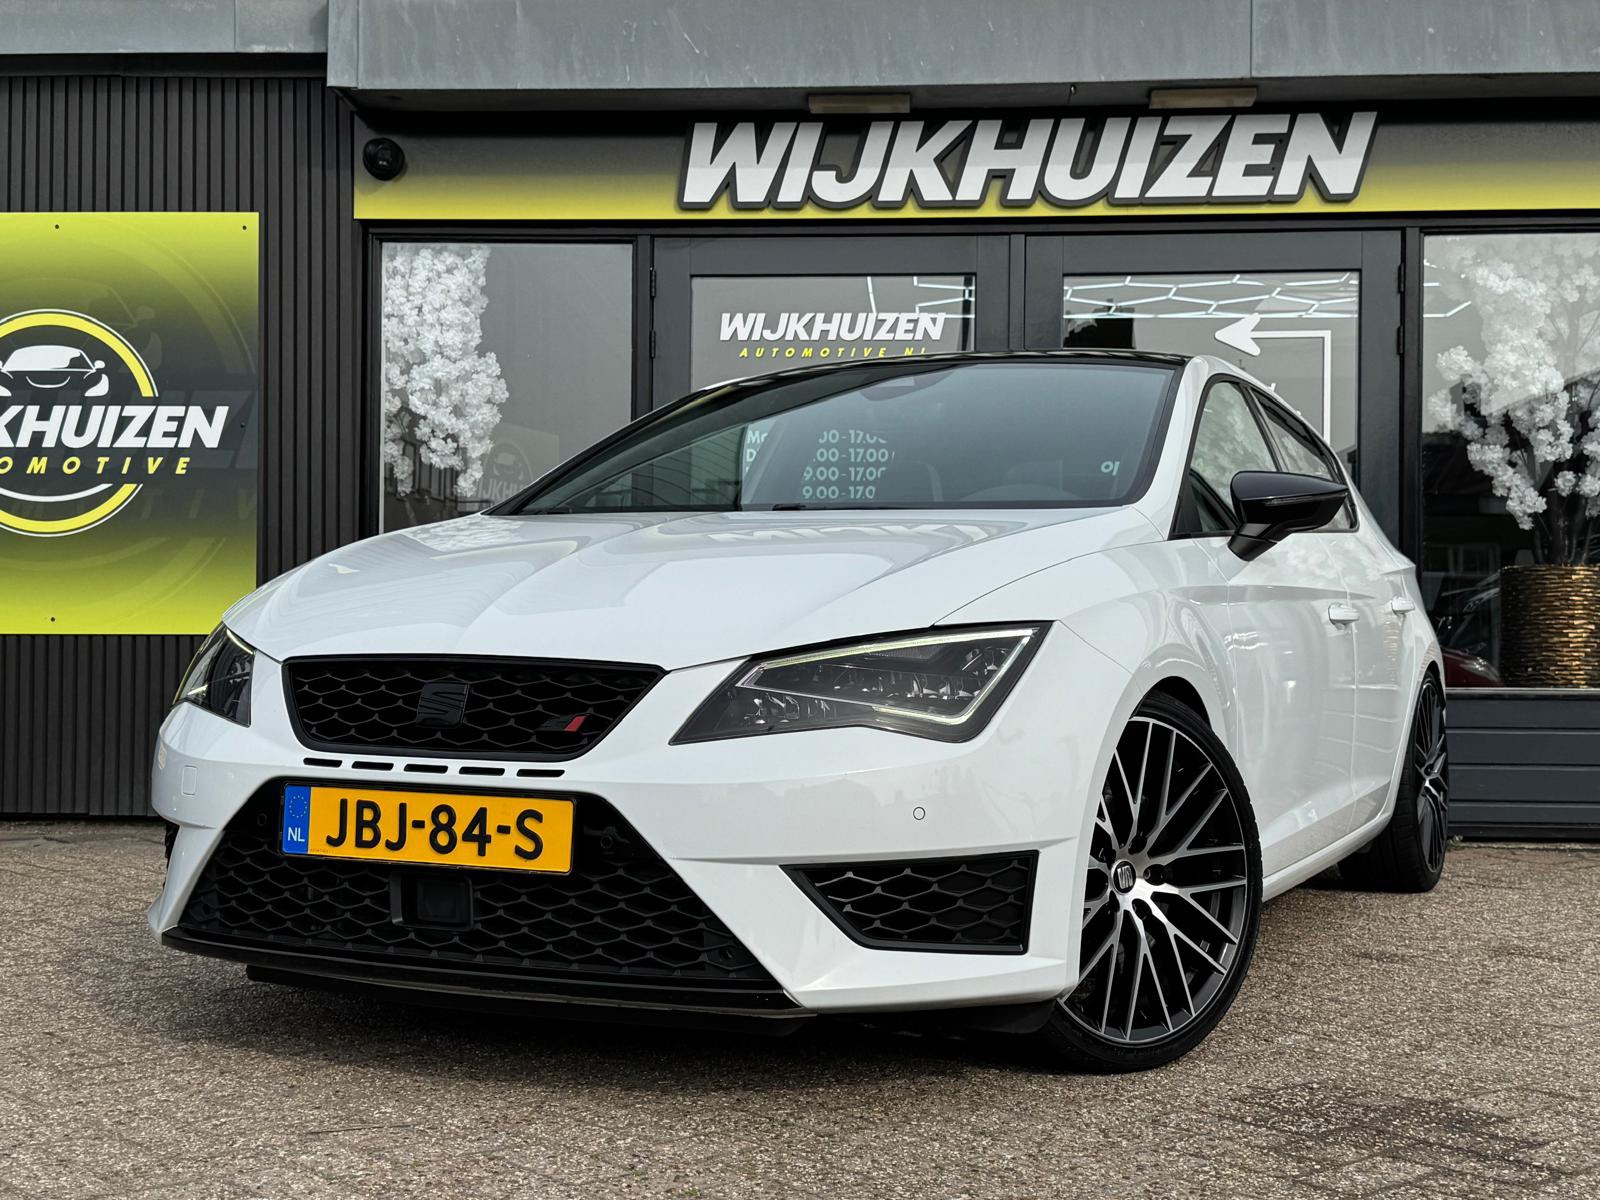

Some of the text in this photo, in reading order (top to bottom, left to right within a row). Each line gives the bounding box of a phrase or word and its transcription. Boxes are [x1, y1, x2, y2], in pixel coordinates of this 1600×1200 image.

[682, 112, 1377, 203] WIJKHUIZEN
[719, 312, 945, 341] WIJKHUIZEN
[739, 347, 887, 358] AUTOMOTIVE
[287, 826, 305, 842] NL
[325, 798, 544, 861] JBJ-84-S
